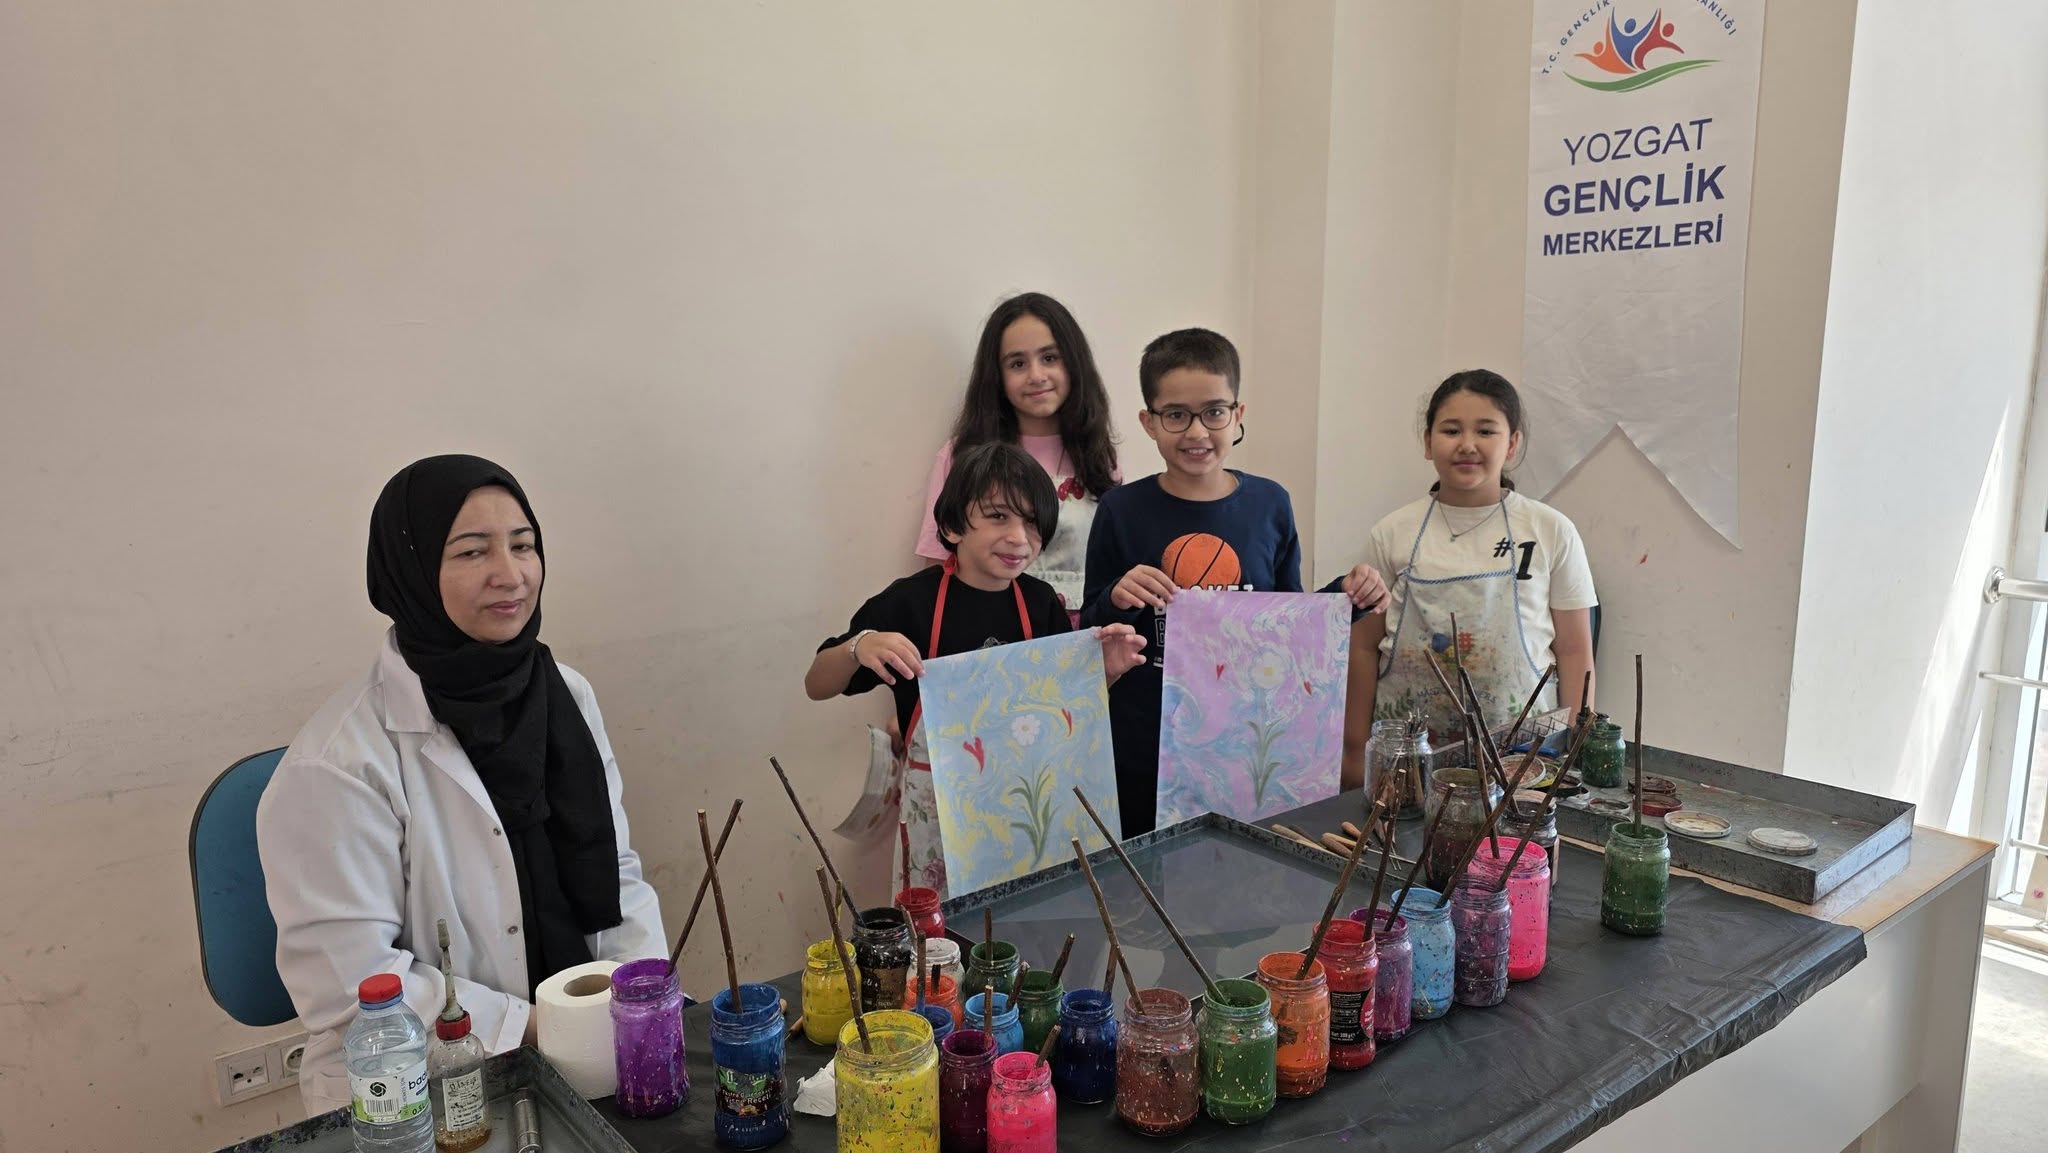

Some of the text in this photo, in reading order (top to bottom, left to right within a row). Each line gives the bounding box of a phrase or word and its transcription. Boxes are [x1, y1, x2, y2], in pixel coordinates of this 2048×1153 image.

[1541, 51, 1560, 74] T.C.
[1696, 0, 1737, 36] ANLIĞI
[1563, 117, 1713, 166] YOZGAT
[1544, 162, 1726, 217] GENÇLİK
[1543, 213, 1723, 256] MERKEZLERİ
[1493, 537, 1537, 580] #1
